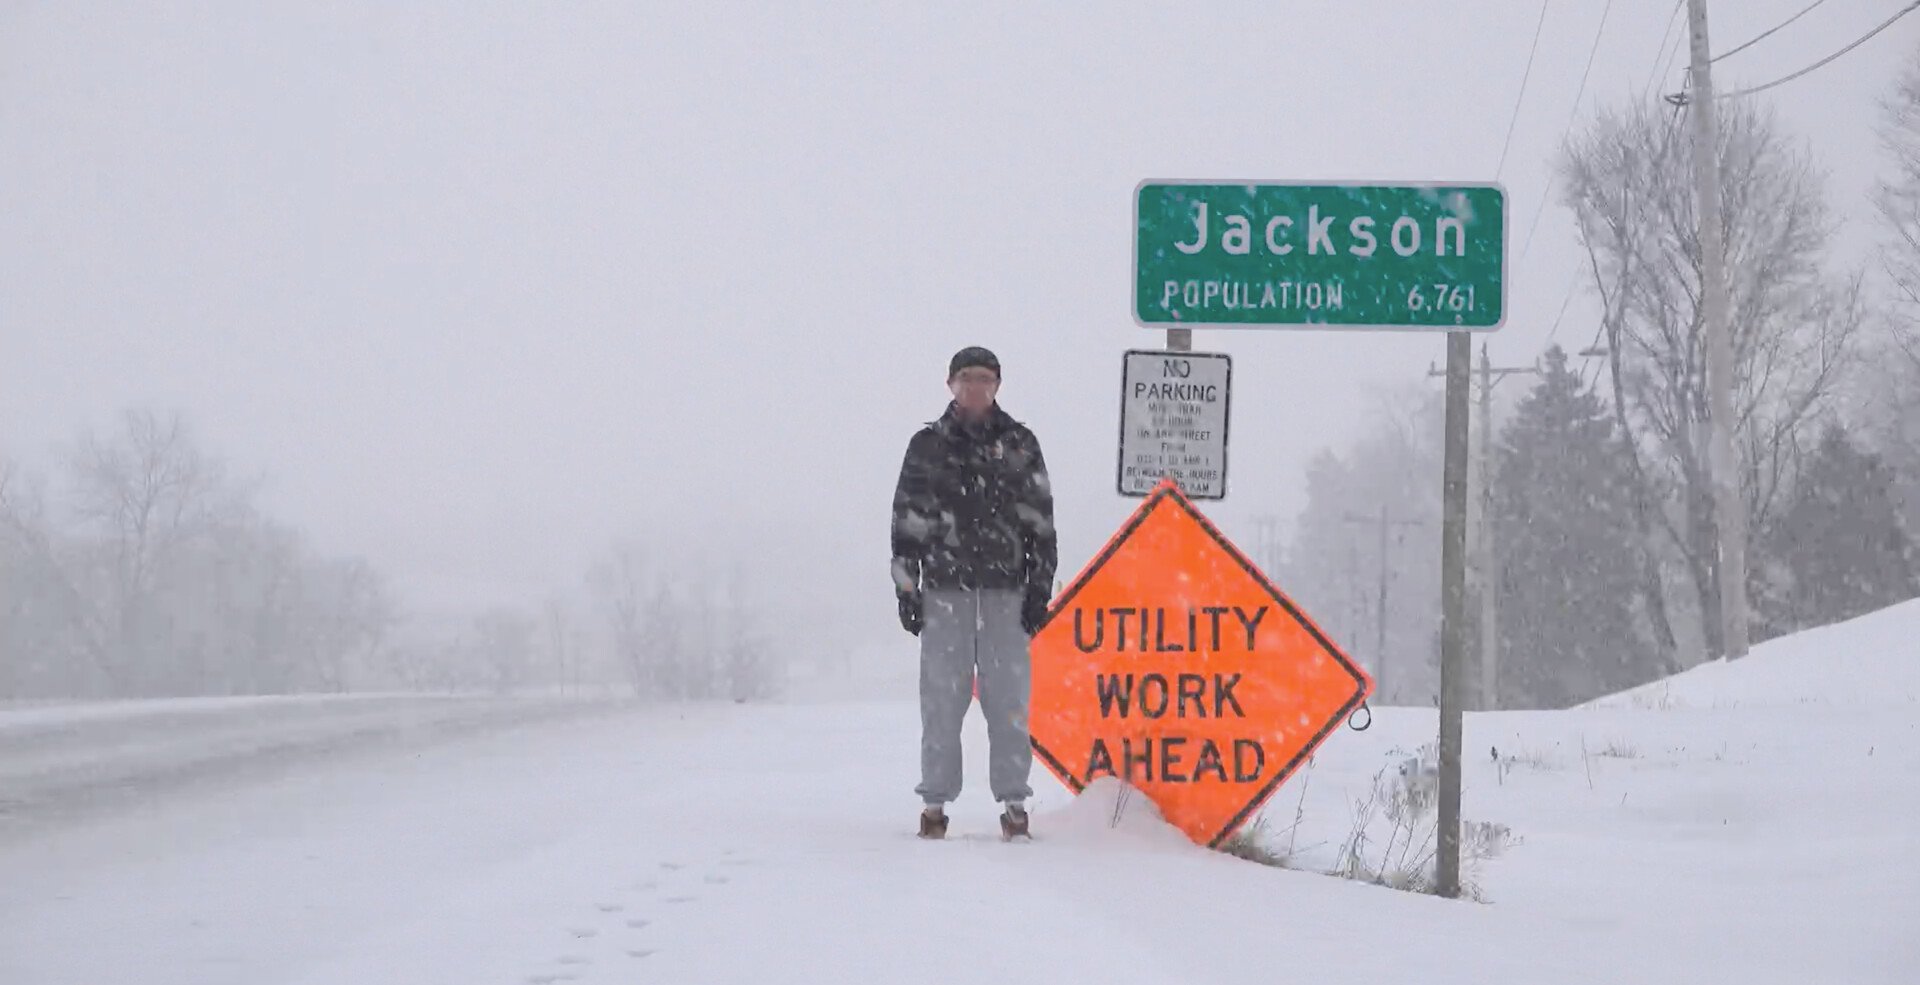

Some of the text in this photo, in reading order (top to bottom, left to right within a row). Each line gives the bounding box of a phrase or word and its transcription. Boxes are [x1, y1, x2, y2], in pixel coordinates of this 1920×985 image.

[1173, 201, 1466, 257] Jackson
[1162, 280, 1475, 314] POPULATION 6,761
[1134, 381, 1217, 403] PARKING
[1162, 359, 1191, 379] NO
[1073, 606, 1269, 653] UTILITY
[1096, 672, 1246, 719] WORK
[1084, 737, 1266, 783] AHEAD
